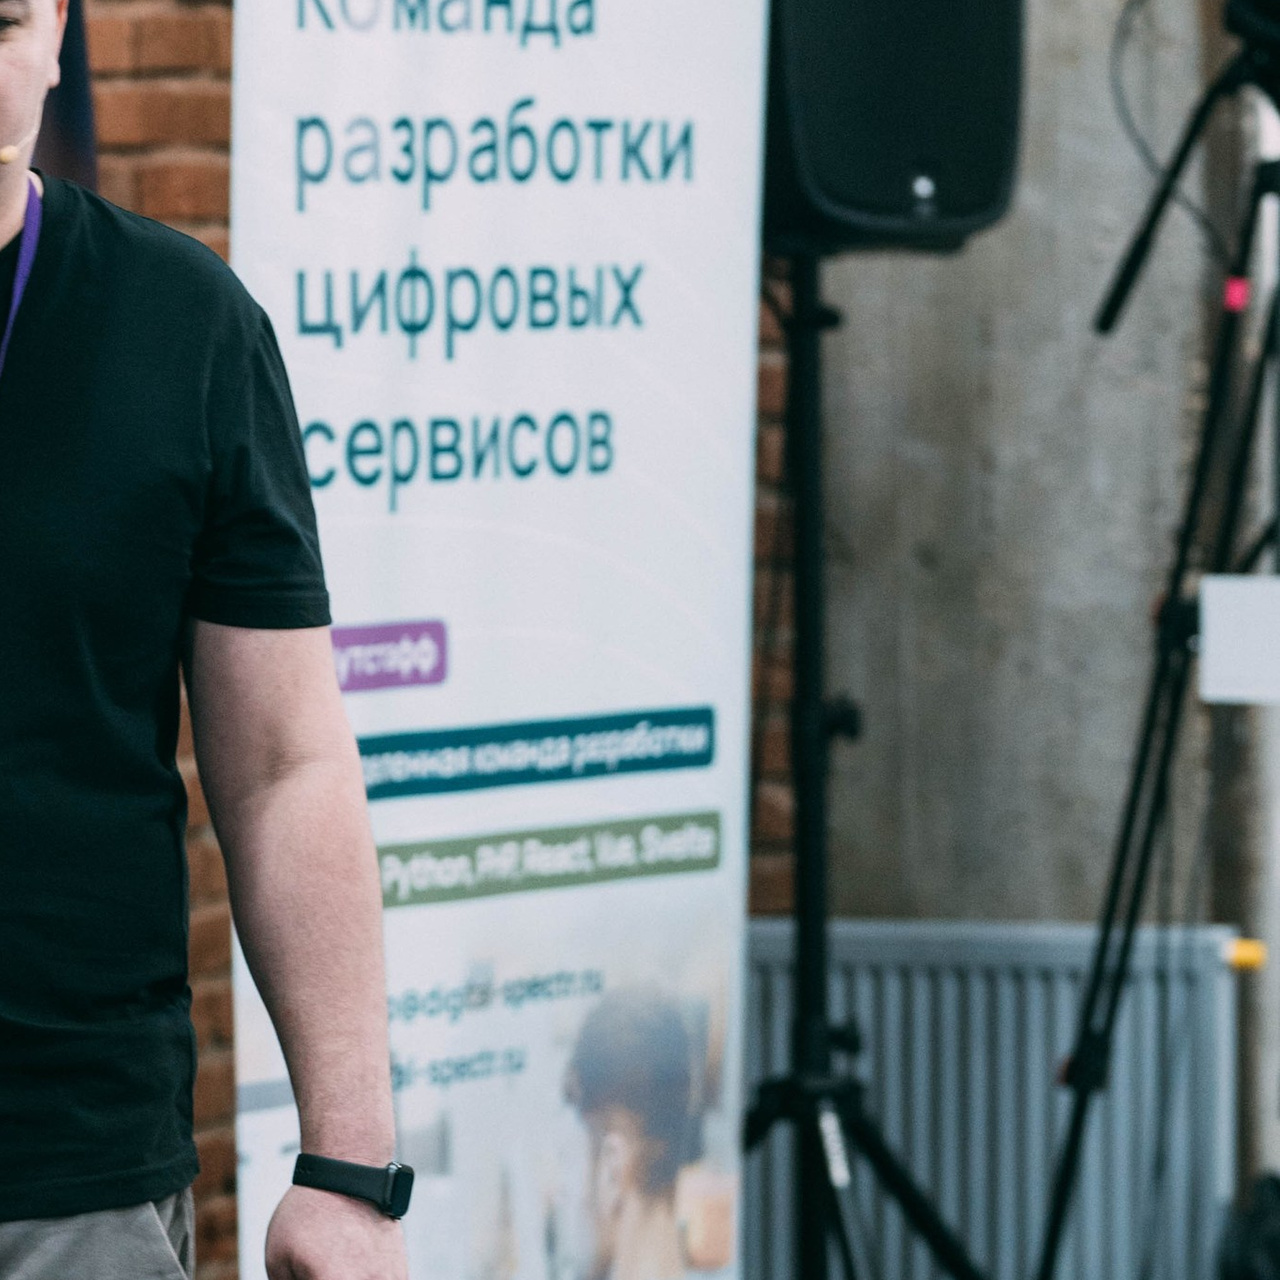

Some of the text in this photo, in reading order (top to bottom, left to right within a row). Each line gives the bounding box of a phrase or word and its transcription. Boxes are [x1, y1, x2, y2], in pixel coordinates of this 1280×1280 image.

[295, 97, 696, 212] разработки
[295, 248, 645, 360] цифровых
[303, 409, 616, 513] сервисов
